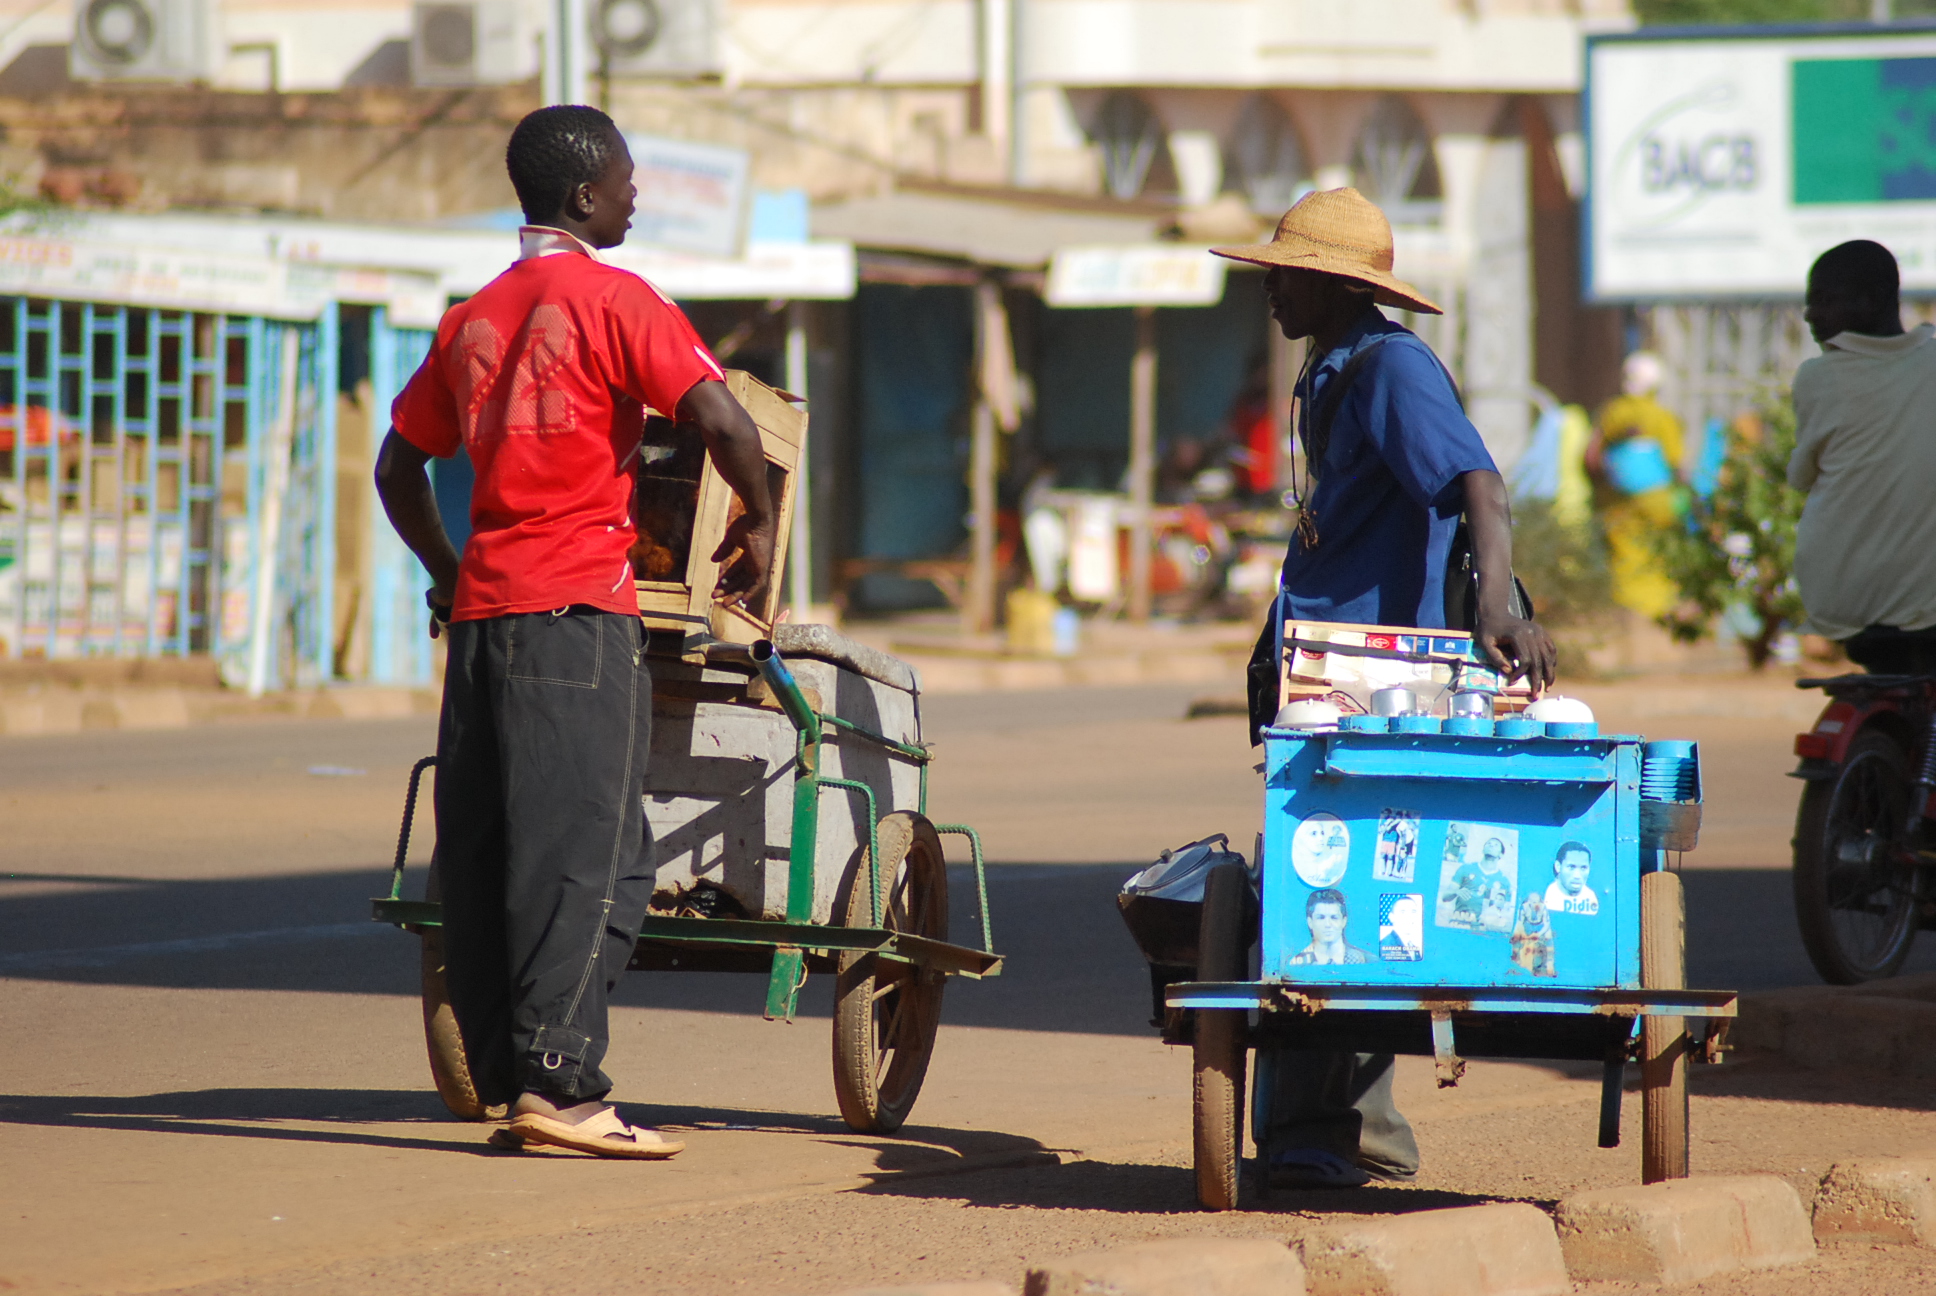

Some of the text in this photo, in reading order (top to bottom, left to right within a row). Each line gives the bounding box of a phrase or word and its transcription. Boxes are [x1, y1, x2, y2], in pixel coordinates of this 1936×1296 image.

[1643, 135, 1757, 191] BACB
[451, 303, 578, 445] 22
[1563, 898, 1598, 912] Didie
